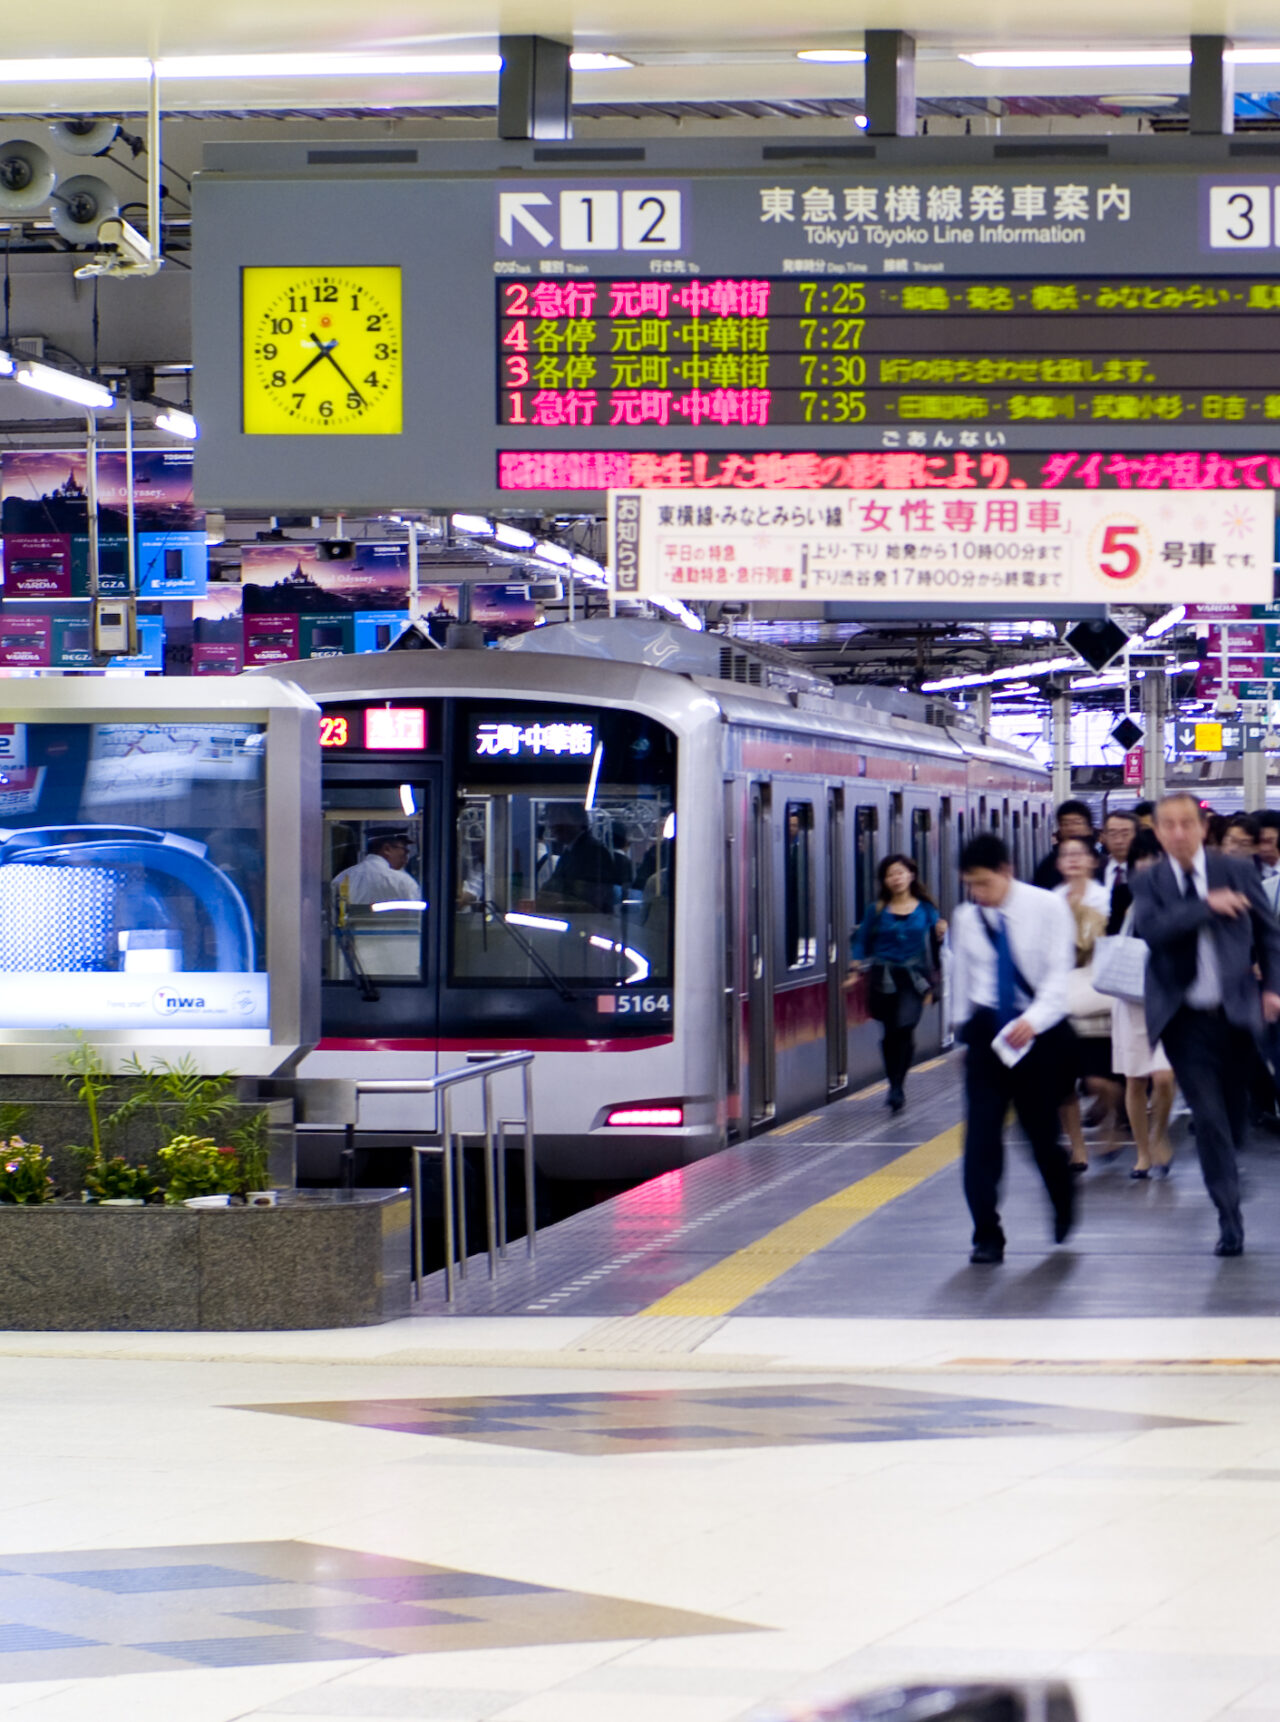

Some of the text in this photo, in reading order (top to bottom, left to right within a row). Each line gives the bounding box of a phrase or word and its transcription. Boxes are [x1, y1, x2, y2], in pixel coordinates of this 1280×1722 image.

[760, 185, 1131, 223] 東急東横線発車案内
[581, 197, 665, 242] 1 2
[1227, 194, 1253, 240] 3
[934, 224, 973, 243] Line
[980, 222, 1085, 243] Information
[314, 285, 338, 302] 12
[351, 295, 359, 310] 1
[505, 284, 529, 316] 2
[531, 281, 597, 318] 急行
[609, 280, 771, 318] 元町・中華街
[800, 283, 866, 313] 7:25
[289, 296, 308, 312] 11
[271, 318, 293, 334] 10
[366, 315, 381, 331] 2
[503, 320, 529, 352] 4
[533, 319, 597, 353] 各停
[611, 318, 770, 353] 元町・中華街
[800, 319, 866, 349] 7:27
[263, 344, 278, 360] 9
[374, 344, 389, 360] 3
[271, 371, 286, 387] 8
[364, 371, 379, 387] 4
[505, 355, 529, 387] 3
[533, 354, 597, 388] 各停
[611, 354, 770, 388] 元町・中華街
[800, 355, 866, 385] 7:30
[292, 393, 306, 409] 7
[319, 401, 333, 417] 6
[346, 391, 362, 409] 5
[508, 392, 527, 424] 1
[531, 390, 598, 426] 急行
[609, 389, 771, 426] 元町・中華街
[800, 391, 866, 422] 7:35
[882, 430, 1006, 448] ごあんない
[658, 505, 843, 526] 東横線・みなとみらい線
[617, 499, 637, 588] お知らせ
[1100, 526, 1141, 579] 5
[319, 717, 348, 746] 23
[166, 997, 206, 1008] nwa
[617, 994, 670, 1013] 5164
